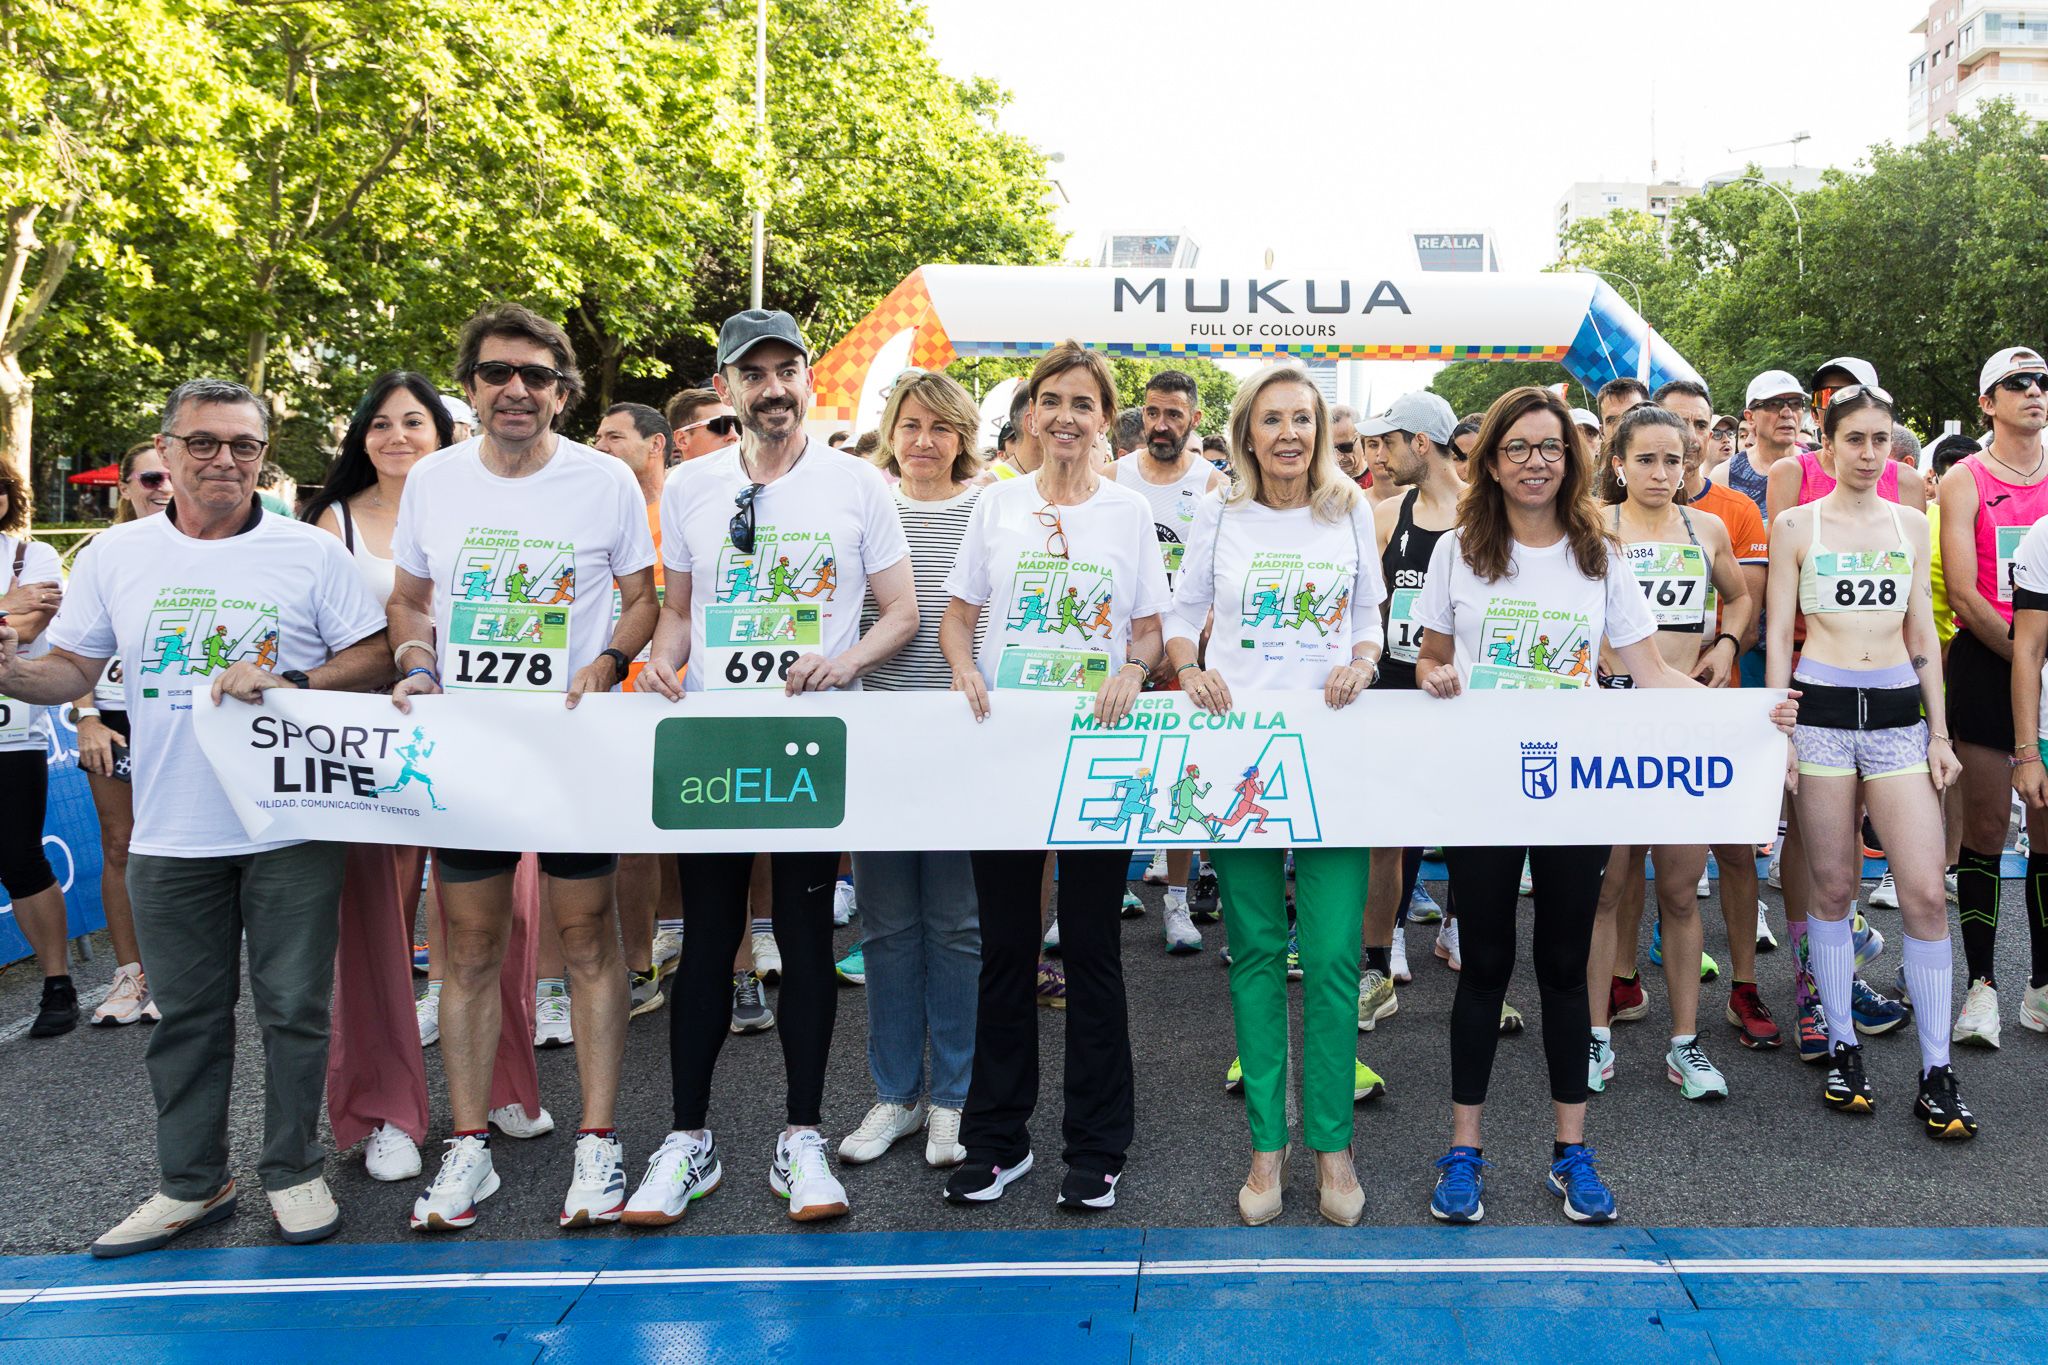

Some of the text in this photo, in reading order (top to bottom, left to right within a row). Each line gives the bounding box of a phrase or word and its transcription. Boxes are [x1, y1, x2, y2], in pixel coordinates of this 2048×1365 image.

[1419, 235, 1480, 248] REALIA
[1113, 277, 1413, 315] MUKUA
[1191, 324, 1337, 337] FULL OF COLOURS
[464, 537, 575, 551] MADRID CON LA
[481, 527, 519, 536] Carrera
[724, 532, 831, 544] MRID CON LA
[715, 543, 837, 593] ELA
[1017, 560, 1113, 577] MADRID CON LA
[1251, 560, 1304, 569] MADRID
[1307, 562, 1334, 571] CON
[1266, 552, 1301, 560] Carrera
[451, 547, 576, 598] ELA
[173, 587, 216, 596] Carrera
[1007, 571, 1113, 621] ELA
[1242, 569, 1352, 616] ELA
[1502, 598, 1537, 607] Carrera
[1638, 580, 1697, 607] 767
[1834, 578, 1897, 606] 828
[153, 598, 279, 614] MADRID CON LA
[1486, 607, 1589, 623] MADRID CON LA
[141, 609, 280, 662] ELA
[470, 613, 543, 643] ELA
[729, 614, 796, 642] ELA
[1479, 617, 1591, 669] ELA
[456, 650, 553, 686] 1278
[725, 650, 800, 684] 698
[1019, 659, 1085, 688] ELA
[1189, 711, 1246, 730] CON
[1253, 711, 1288, 730] LA
[250, 716, 400, 759] SPORT
[274, 756, 379, 799] LIFE
[680, 767, 818, 804] adELA
[1046, 733, 1323, 845] ELA
[1570, 756, 1734, 797] MADRID
[301, 799, 372, 811] COMUNICACIÓN
[381, 806, 421, 817] EVENTOS
